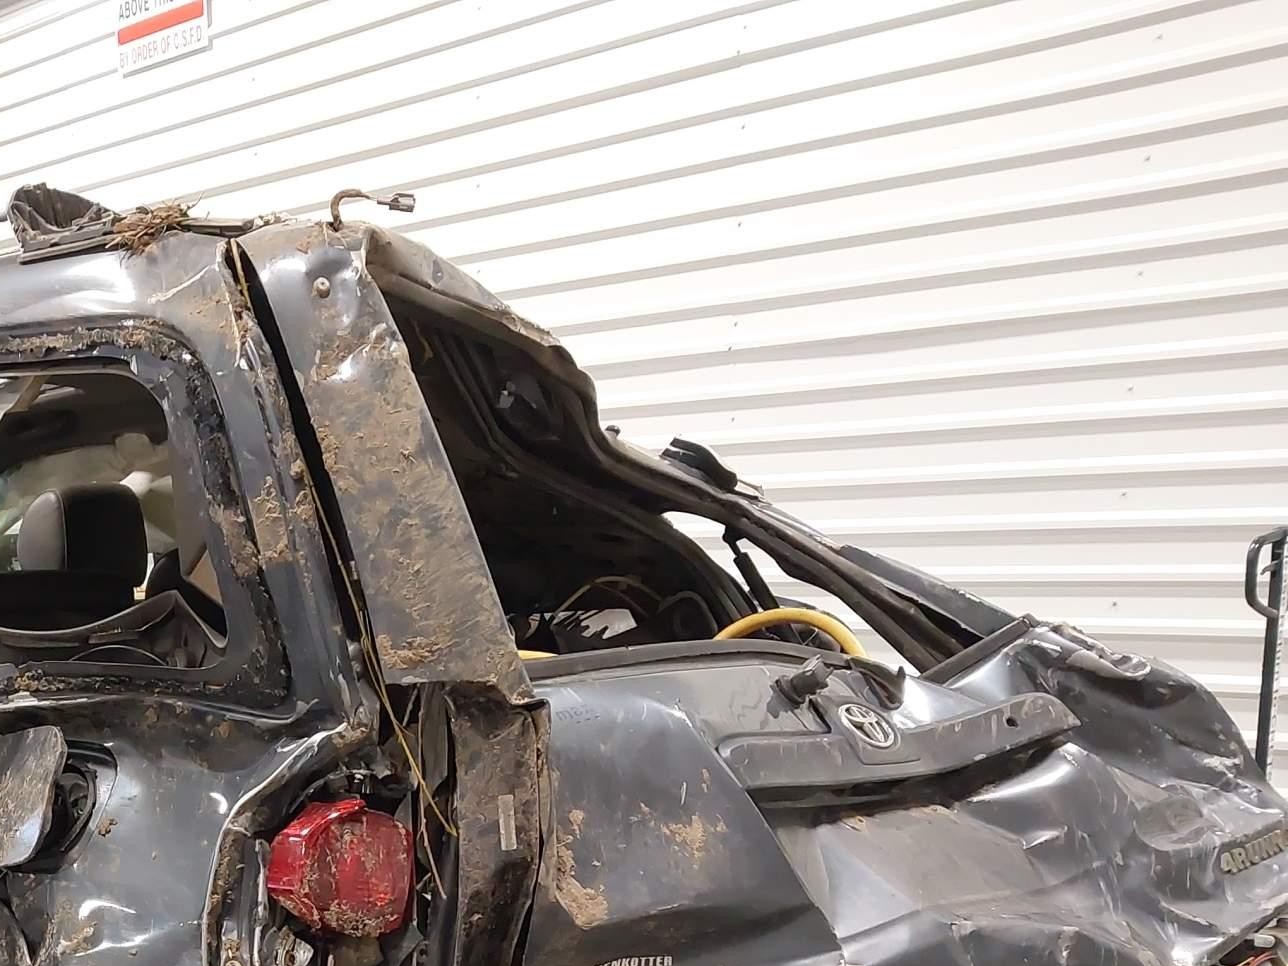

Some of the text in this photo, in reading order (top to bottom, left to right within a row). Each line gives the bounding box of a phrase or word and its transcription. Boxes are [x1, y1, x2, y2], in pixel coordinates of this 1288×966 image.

[119, 0, 150, 21] ABOVE
[132, 41, 158, 64] ORDER
[161, 35, 171, 54] OF
